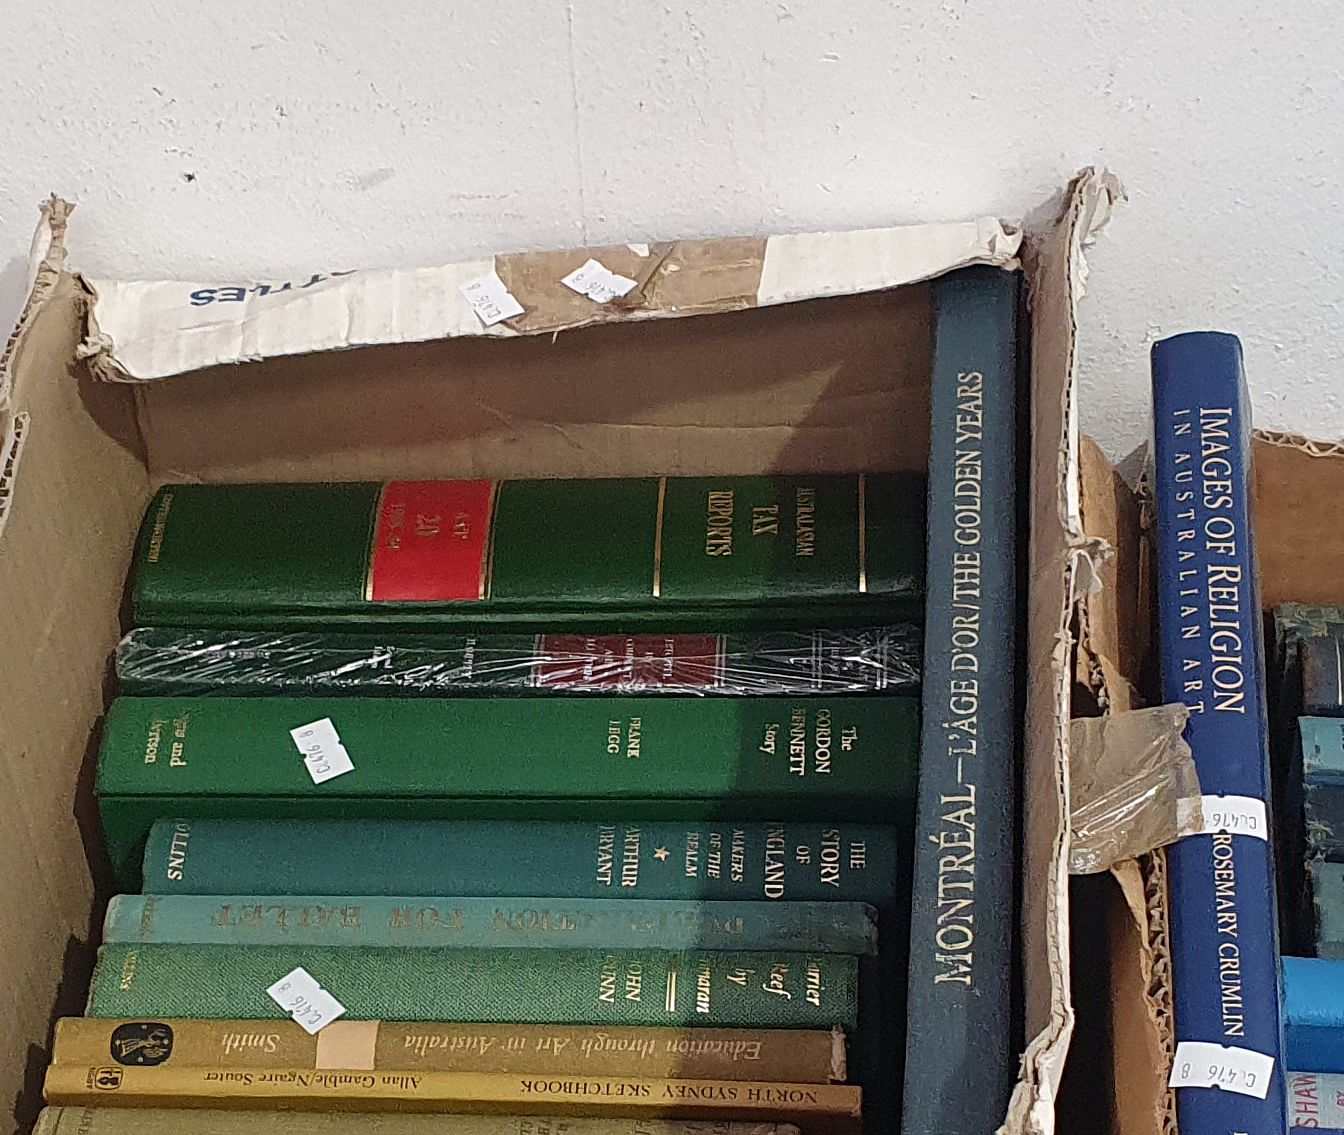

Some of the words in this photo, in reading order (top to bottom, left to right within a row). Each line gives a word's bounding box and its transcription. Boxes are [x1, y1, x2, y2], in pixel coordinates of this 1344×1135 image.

[955, 370, 983, 443] YEARS
[1173, 408, 1191, 438] IN
[1198, 406, 1234, 511] IMAGES
[954, 449, 983, 546] GOLDEN
[706, 490, 733, 556] REPORTS
[752, 504, 779, 536] TAX
[1203, 515, 1235, 558] OF
[1174, 450, 1201, 642] AUSTRALIAN
[1206, 563, 1245, 715] RELIGION
[1182, 658, 1205, 716] ART
[607, 719, 621, 754] LEGG
[627, 716, 642, 758] FRANK
[759, 722, 780, 755] Story
[790, 706, 806, 776] BENNETT
[815, 709, 831, 774] GORDON
[842, 726, 857, 752] The
[169, 742, 187, 768] and
[596, 824, 615, 886] BRYANT
[621, 826, 641, 888] ARTHUR
[685, 831, 700, 878] REALM
[709, 832, 722, 853] OF
[731, 829, 745, 882] MAKERS
[795, 845, 811, 865] OF
[820, 829, 840, 888] STORY
[850, 839, 866, 869] THE
[707, 853, 721, 879] THE
[931, 780, 977, 988] MONTRÉAL
[1212, 832, 1238, 939] ROSEMARY
[726, 967, 756, 986] by
[762, 962, 792, 1000] Reef
[1218, 940, 1245, 1038] CRUMLIN
[222, 1032, 281, 1054] Smith
[404, 1034, 492, 1055] Australia
[507, 1037, 528, 1053] in
[536, 1037, 571, 1057] Art
[580, 1033, 657, 1056] through
[665, 1036, 763, 1060] Education
[204, 1071, 253, 1084] Souter
[382, 1075, 423, 1089] Allan
[520, 1079, 651, 1098] SKETCHBOOK
[1179, 1062, 1192, 1081] 8
[662, 1084, 737, 1101] SYDNEY
[748, 1087, 818, 1104] NORTH
[1294, 1073, 1320, 1129] SHAW
